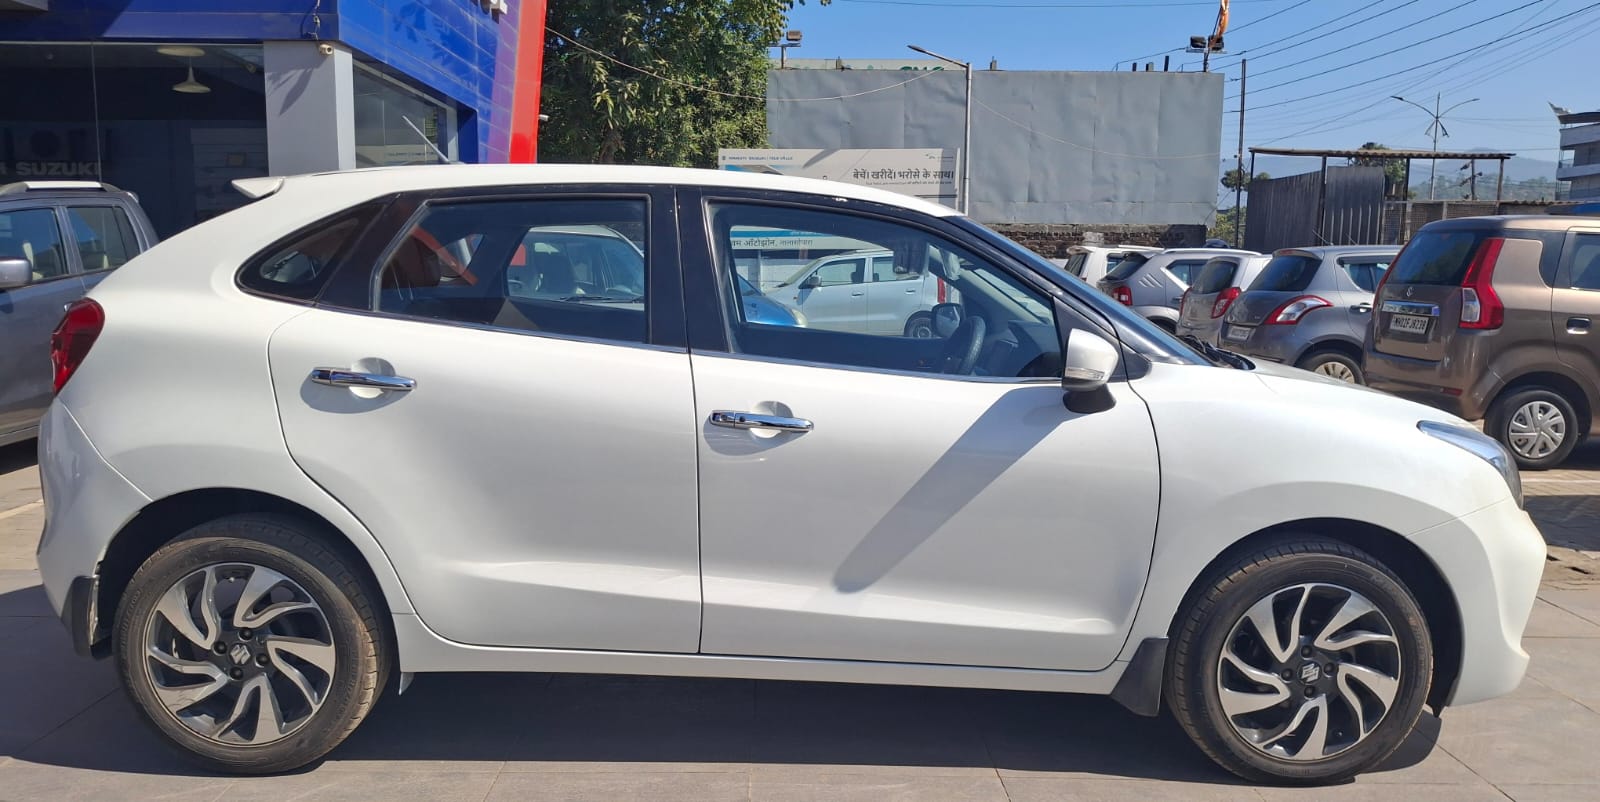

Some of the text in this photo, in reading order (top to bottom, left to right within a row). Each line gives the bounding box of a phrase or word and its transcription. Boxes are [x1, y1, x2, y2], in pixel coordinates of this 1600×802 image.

[15, 161, 99, 176] SUZUKI
[871, 168, 896, 179] खरीदें।
[898, 168, 920, 179] भरोसे
[922, 168, 931, 179] के
